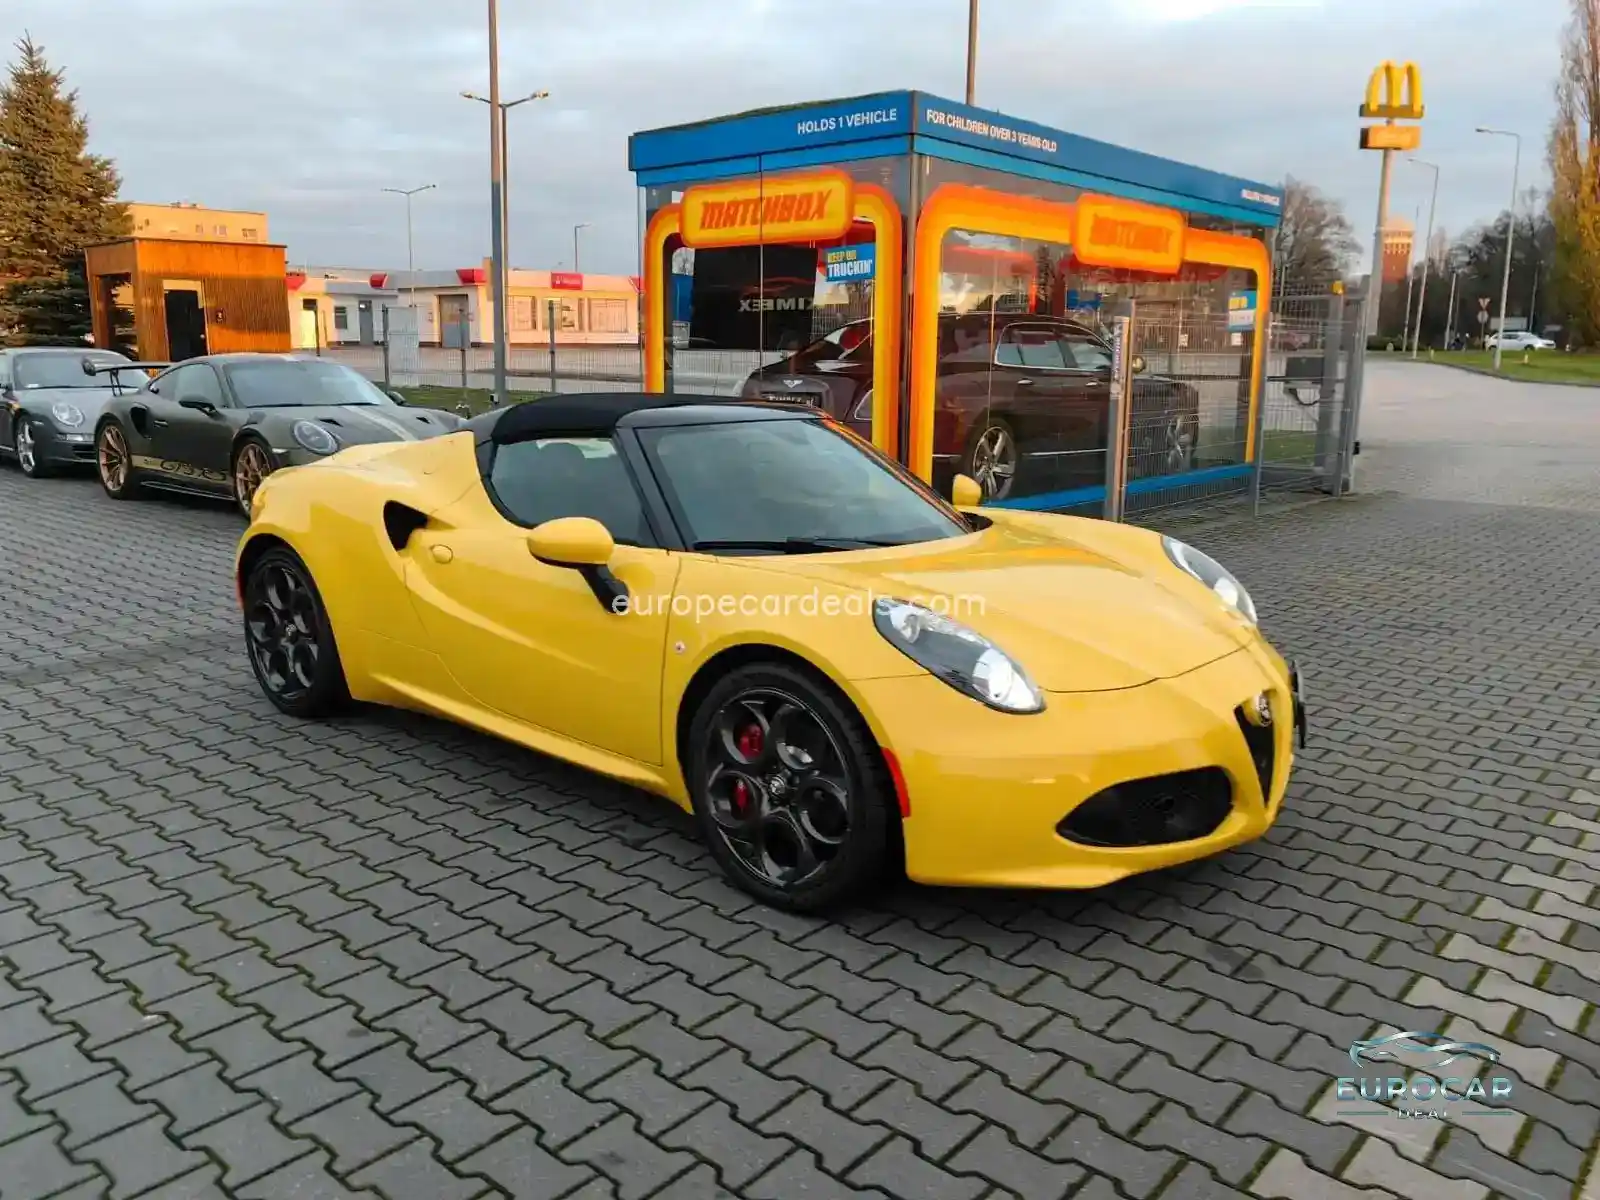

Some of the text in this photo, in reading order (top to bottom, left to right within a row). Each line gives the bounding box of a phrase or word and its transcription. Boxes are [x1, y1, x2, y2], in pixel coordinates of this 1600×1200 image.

[797, 108, 897, 135] HOLDS 1 VEHICLE
[926, 108, 945, 125] FOR
[946, 113, 989, 136] CHILDREN
[990, 125, 1011, 141] OVER
[1018, 131, 1041, 149] YEARS
[1042, 139, 1057, 152] OLD
[699, 188, 832, 231] MATCHBOX
